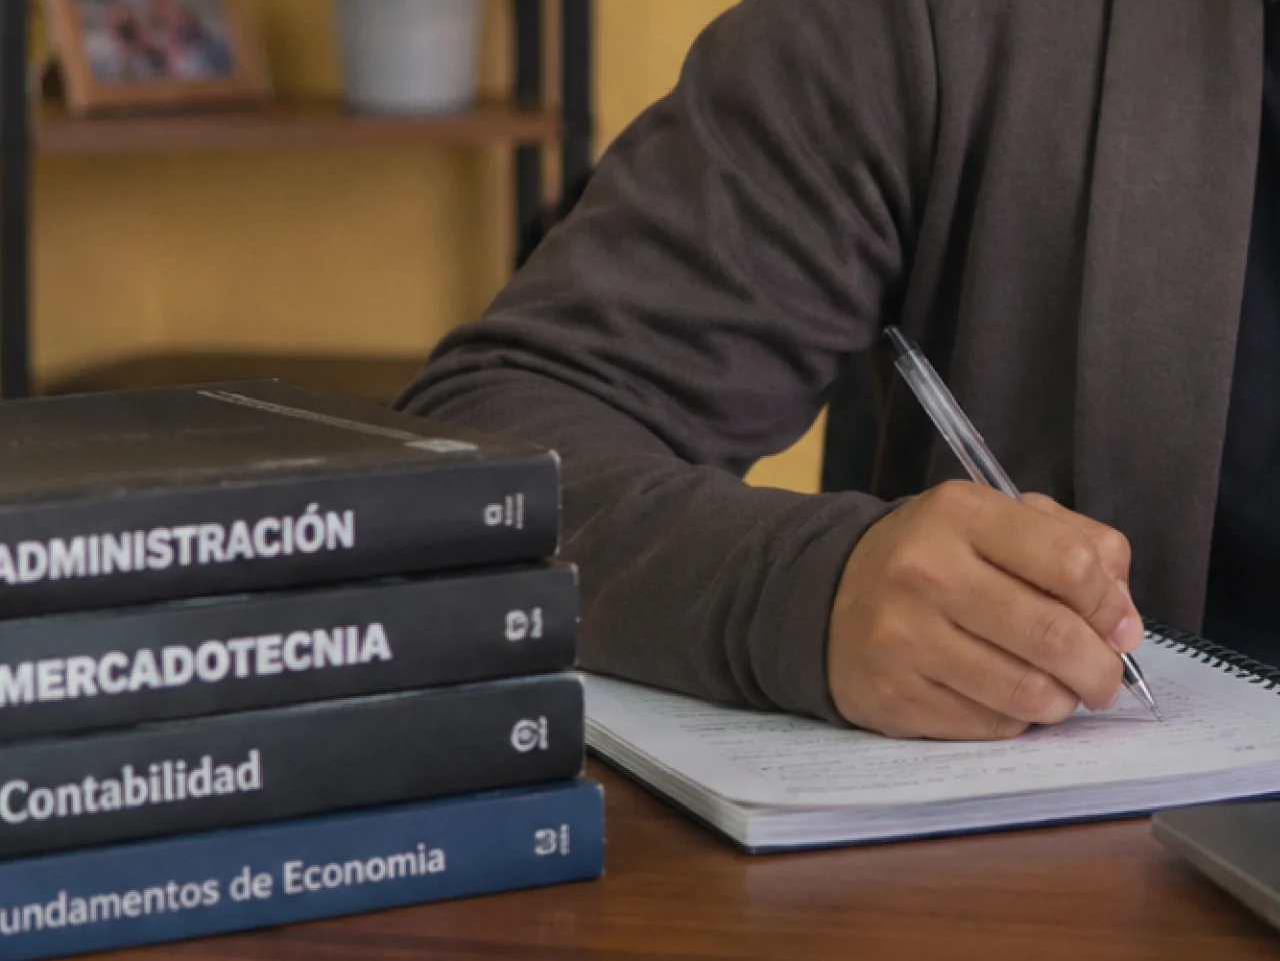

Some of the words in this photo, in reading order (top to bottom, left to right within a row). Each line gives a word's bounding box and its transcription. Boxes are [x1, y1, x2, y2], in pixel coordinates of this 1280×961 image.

[0, 503, 354, 584] ADMINISTRACIÓN
[0, 623, 392, 707] MERCADOTECNIA
[0, 749, 262, 823] Contabilidad
[0, 880, 220, 934] undamentos
[229, 866, 273, 901] de
